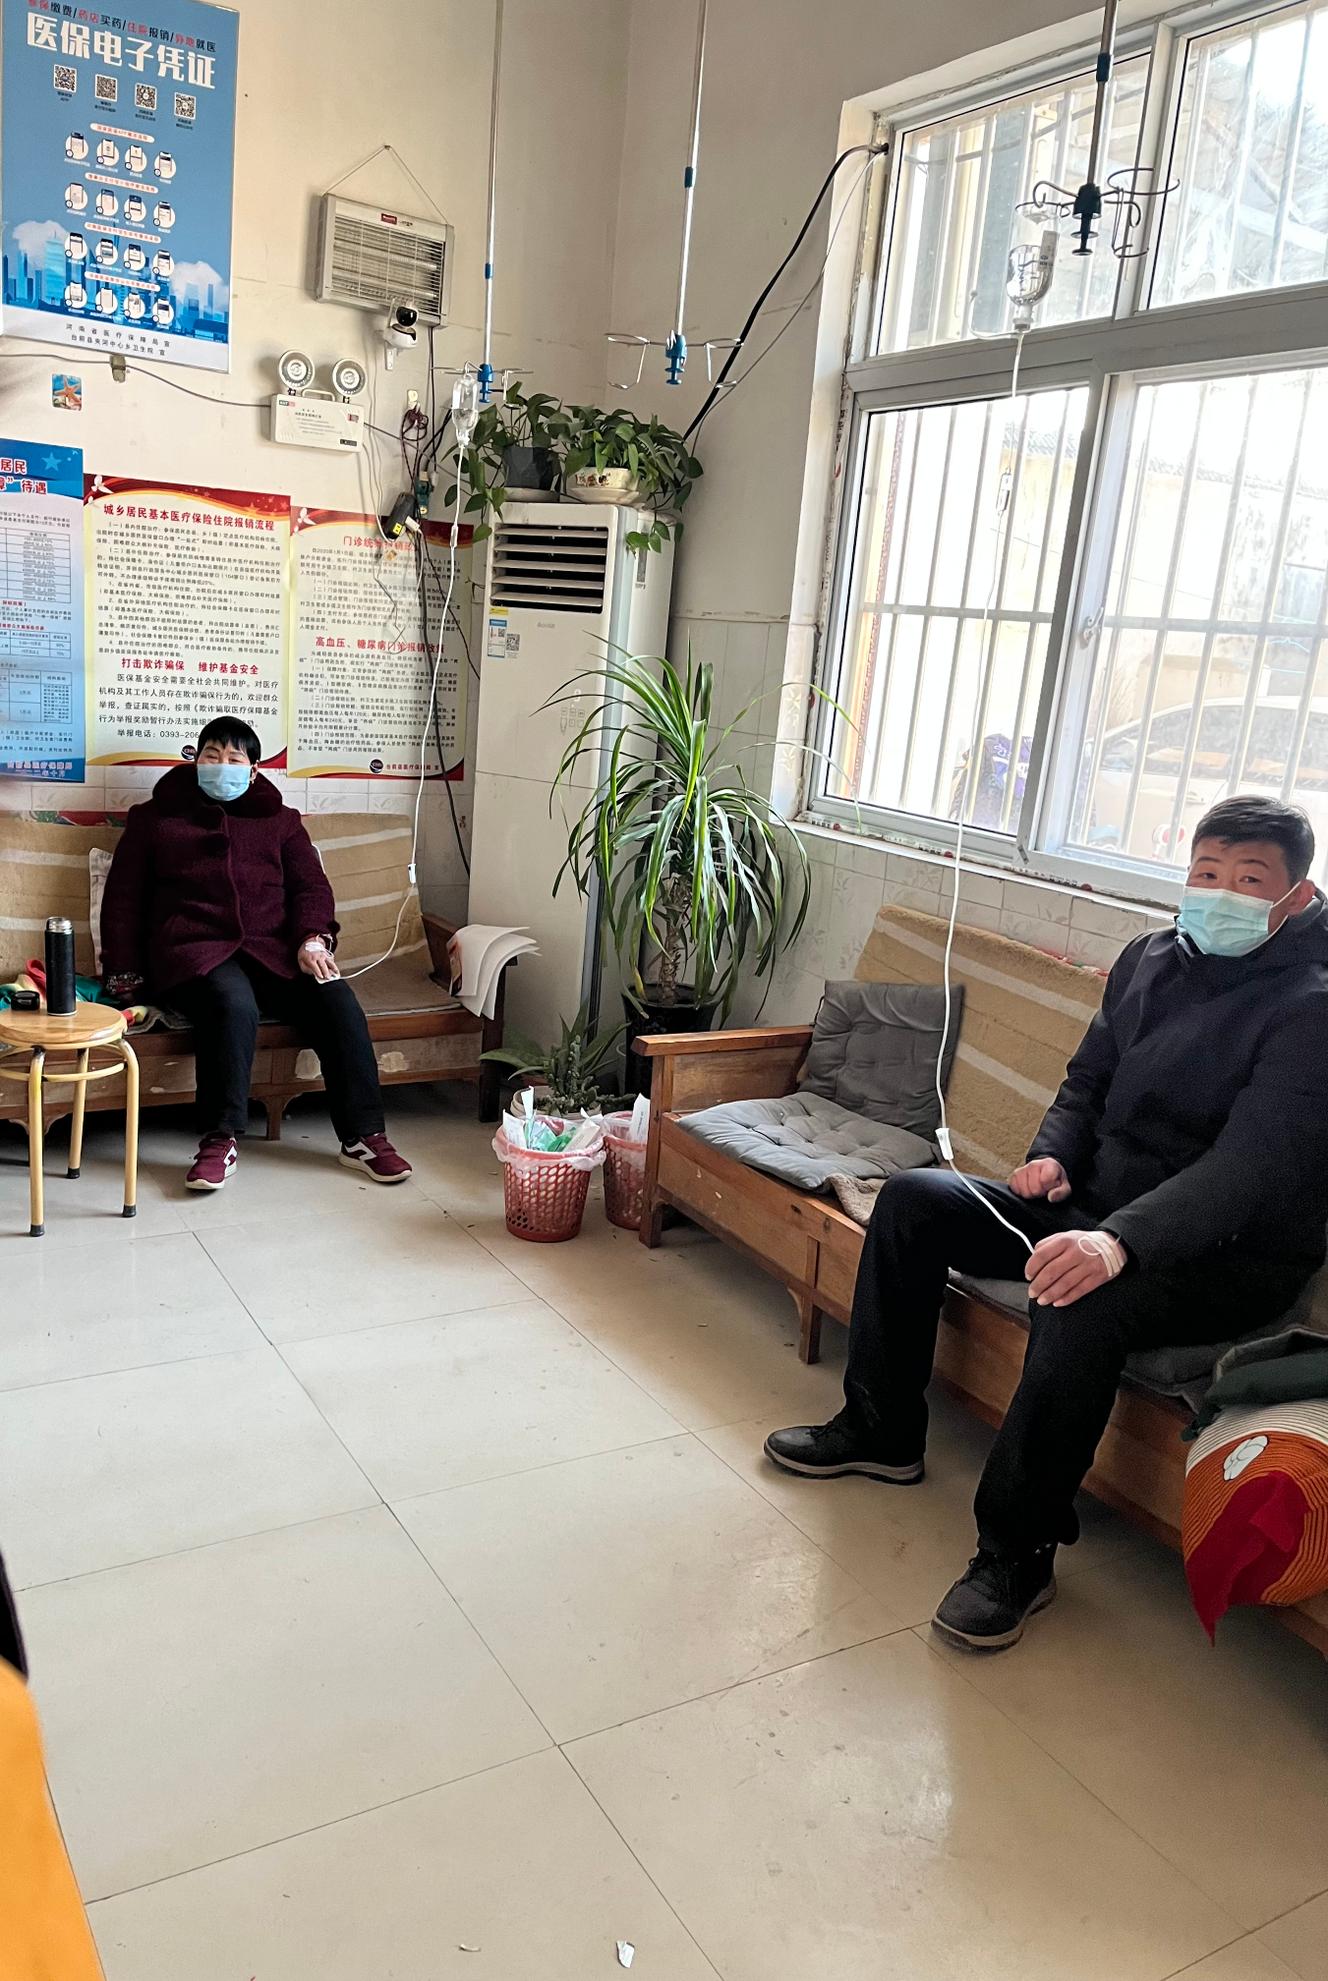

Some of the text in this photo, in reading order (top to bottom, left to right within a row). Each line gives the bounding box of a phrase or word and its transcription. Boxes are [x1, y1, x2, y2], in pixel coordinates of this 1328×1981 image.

[26, 12, 216, 90] 医保电子凭证
[1, 459, 27, 475] 居民
[104, 504, 275, 531] 城乡居民基本医疗保险住院报销流程
[122, 657, 259, 675] 打击欺诈骗保 维护基金安全
[117, 673, 279, 690] 医保基金安全需要全社会共同维护。对医疗
[98, 686, 279, 703] 机构及其工作人员存在欺诈骗保行为的，欢迎群众
